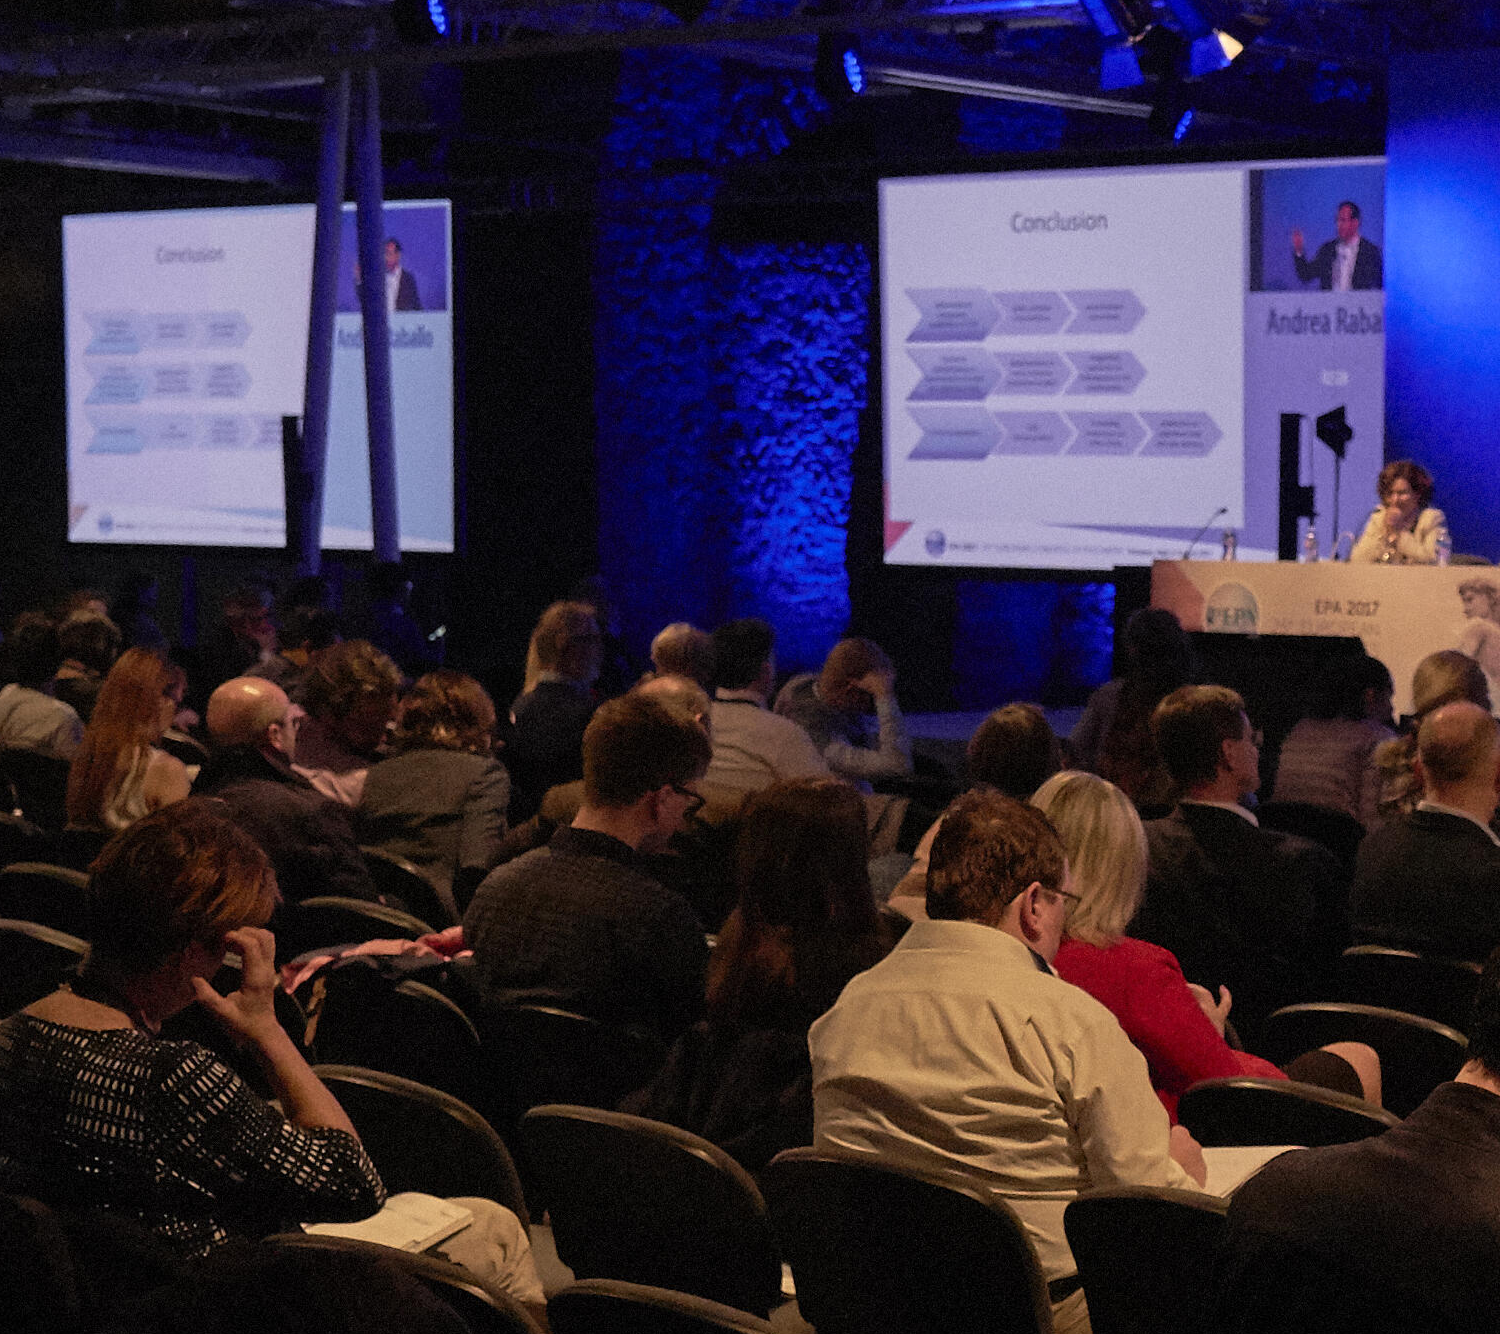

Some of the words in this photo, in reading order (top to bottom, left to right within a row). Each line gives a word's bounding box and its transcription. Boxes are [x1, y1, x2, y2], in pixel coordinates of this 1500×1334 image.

[1010, 210, 1109, 234] Conclusion
[1266, 307, 1331, 335] Andrea
[1336, 307, 1385, 335] Raba
[392, 324, 435, 348] aballo
[1314, 599, 1342, 615] EPA
[1346, 599, 1381, 617] 2017
